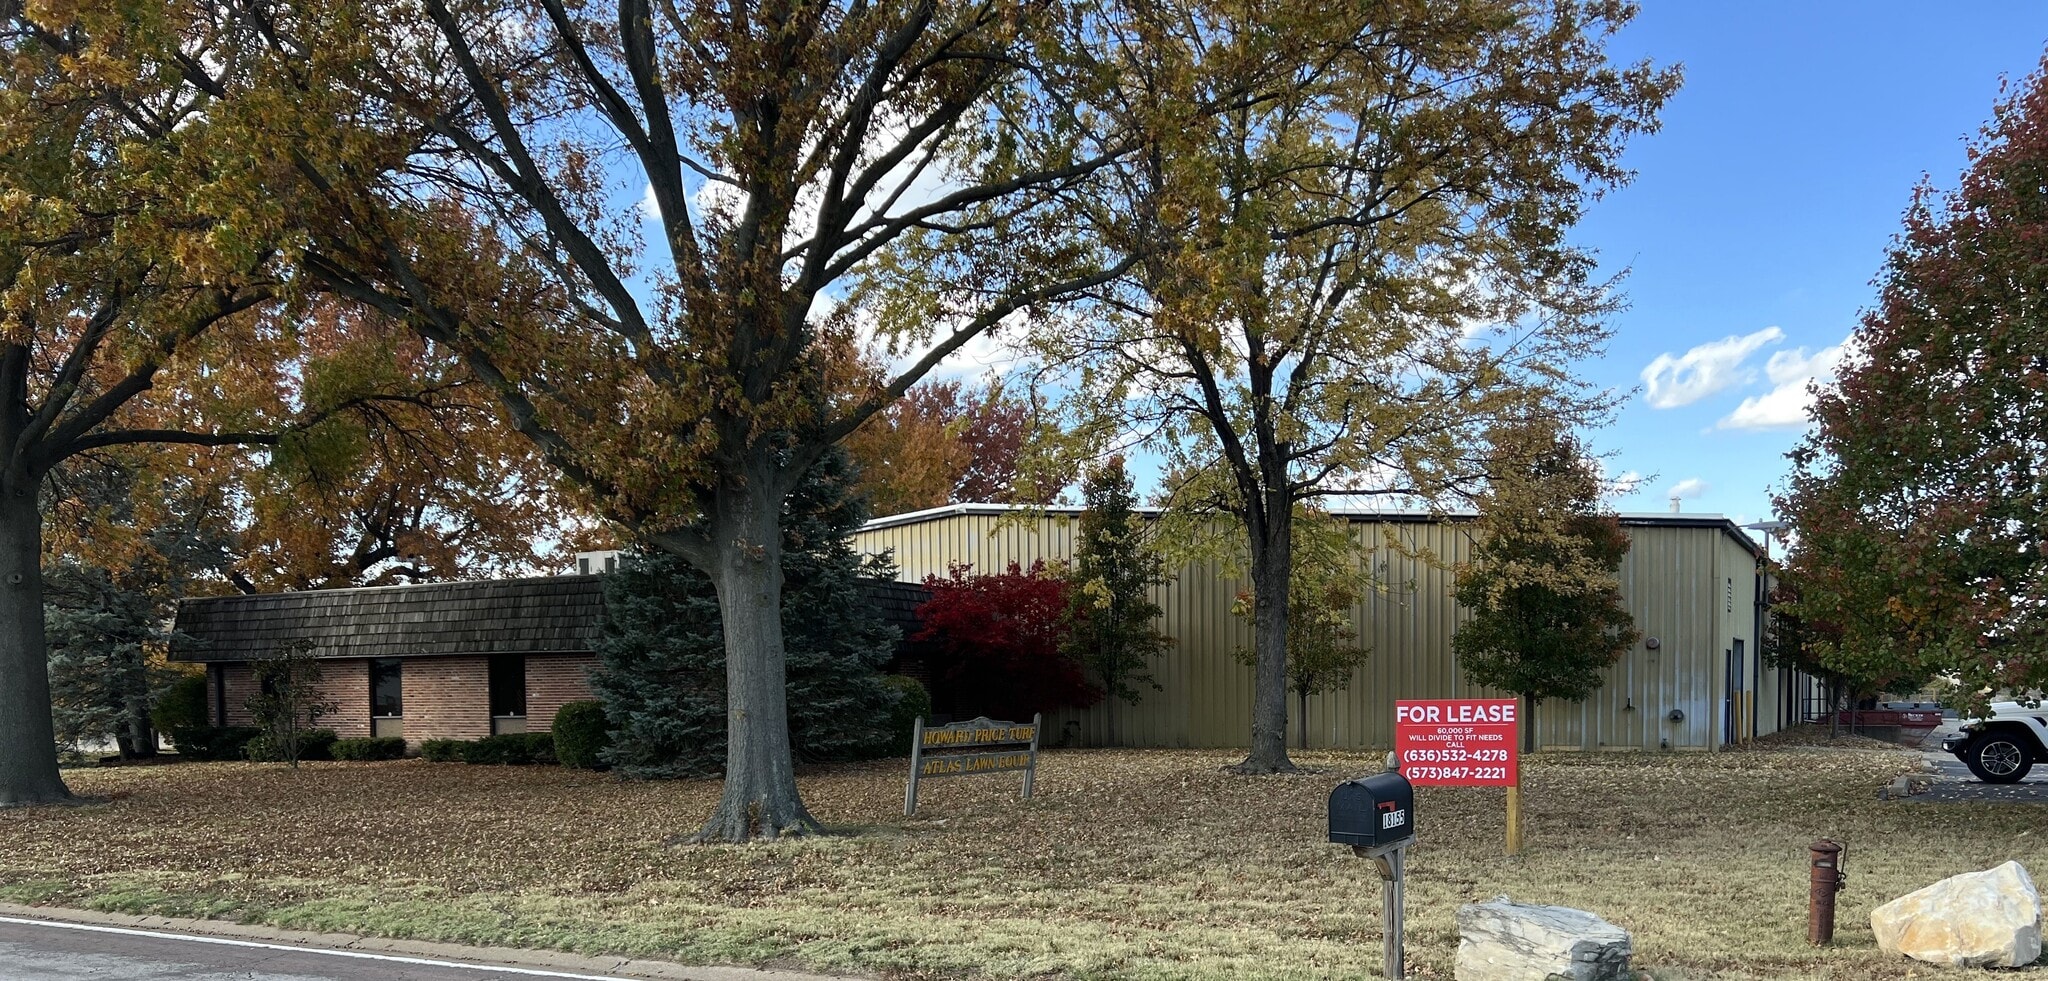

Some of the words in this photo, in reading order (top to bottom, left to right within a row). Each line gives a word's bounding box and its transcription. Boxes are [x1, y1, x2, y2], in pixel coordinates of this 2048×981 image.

[1396, 706, 1440, 722] FOR
[1447, 705, 1515, 722] LEASE
[923, 730, 971, 744] HOWARD
[975, 728, 1005, 742] PRICE
[1009, 727, 1035, 740] TURF
[1437, 727, 1463, 735] 60,000
[1403, 750, 1508, 762] (636)532-4278
[923, 760, 961, 775] ATLAS
[966, 757, 995, 771] LAWN
[999, 754, 1029, 768] EQUIP
[1406, 767, 1506, 780] (573)847-2221
